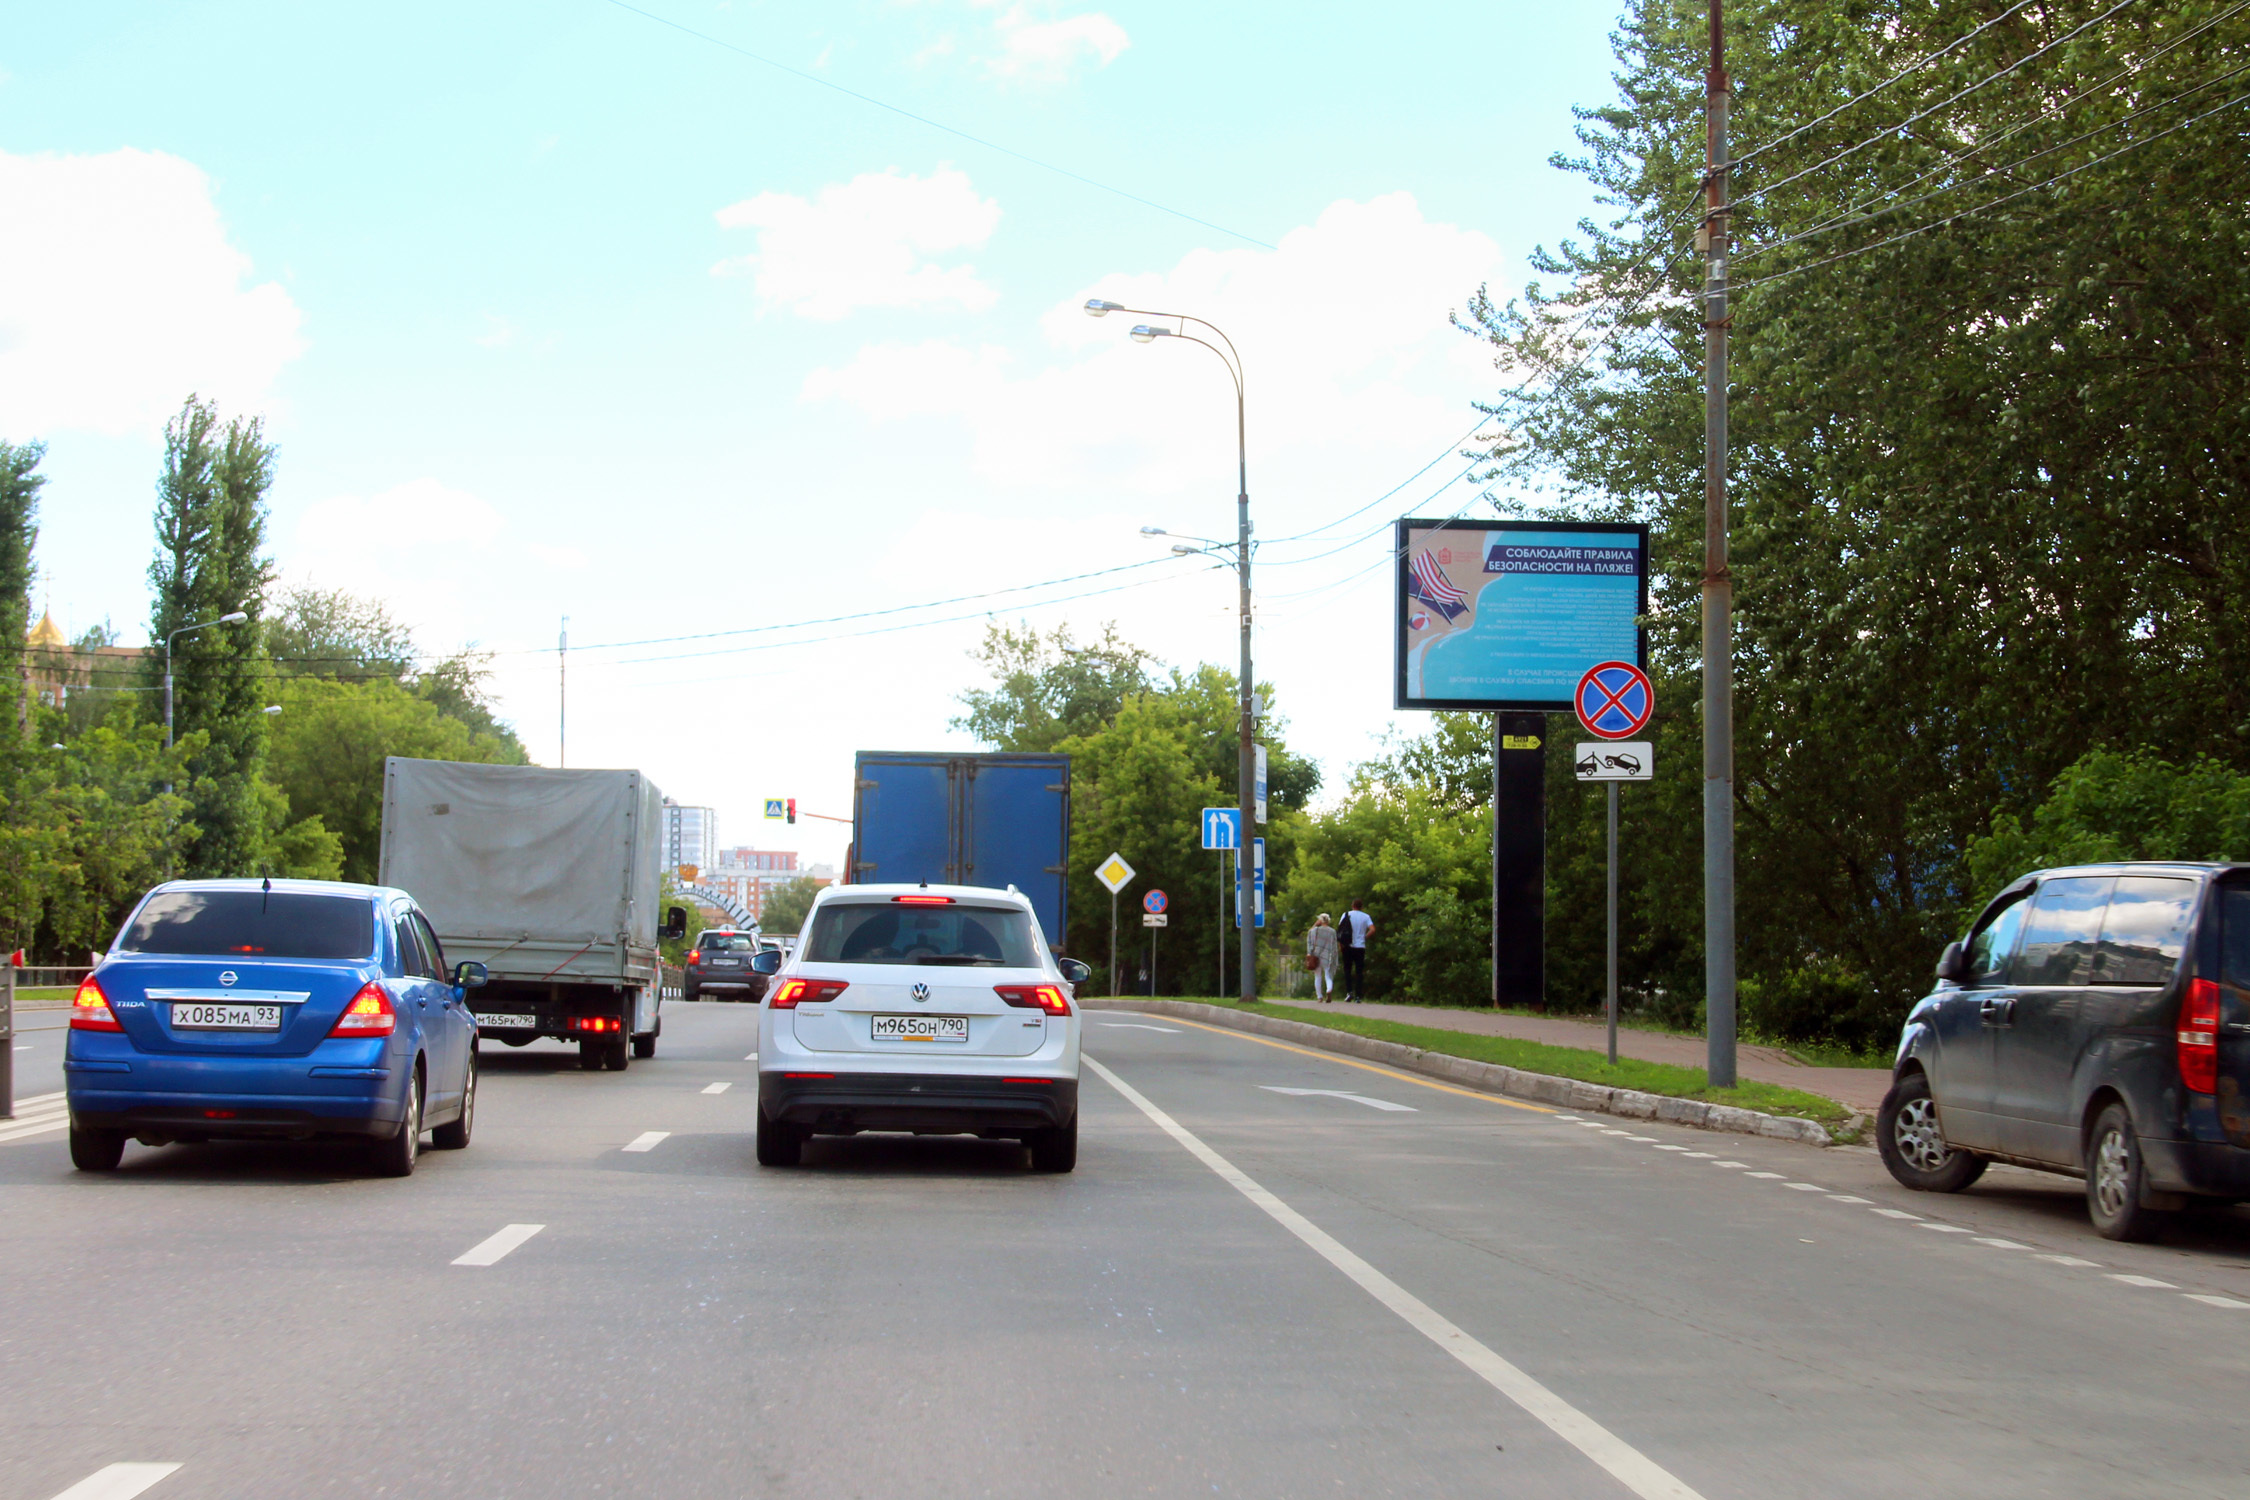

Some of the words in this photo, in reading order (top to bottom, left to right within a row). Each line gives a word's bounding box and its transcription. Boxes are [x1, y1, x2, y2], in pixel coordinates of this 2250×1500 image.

[1506, 547, 1581, 559] СОБЛЮДАЙТЕ
[1584, 550, 1634, 560] ПРАВИЛА
[1488, 561, 1574, 572] БЕЗОПАСНОСТИ
[1576, 563, 1592, 572] НА
[1594, 563, 1634, 573] ПЛЯЖЕ!
[115, 1000, 146, 1008] TIIDA
[257, 1008, 275, 1020] 93
[940, 1018, 963, 1031] 790
